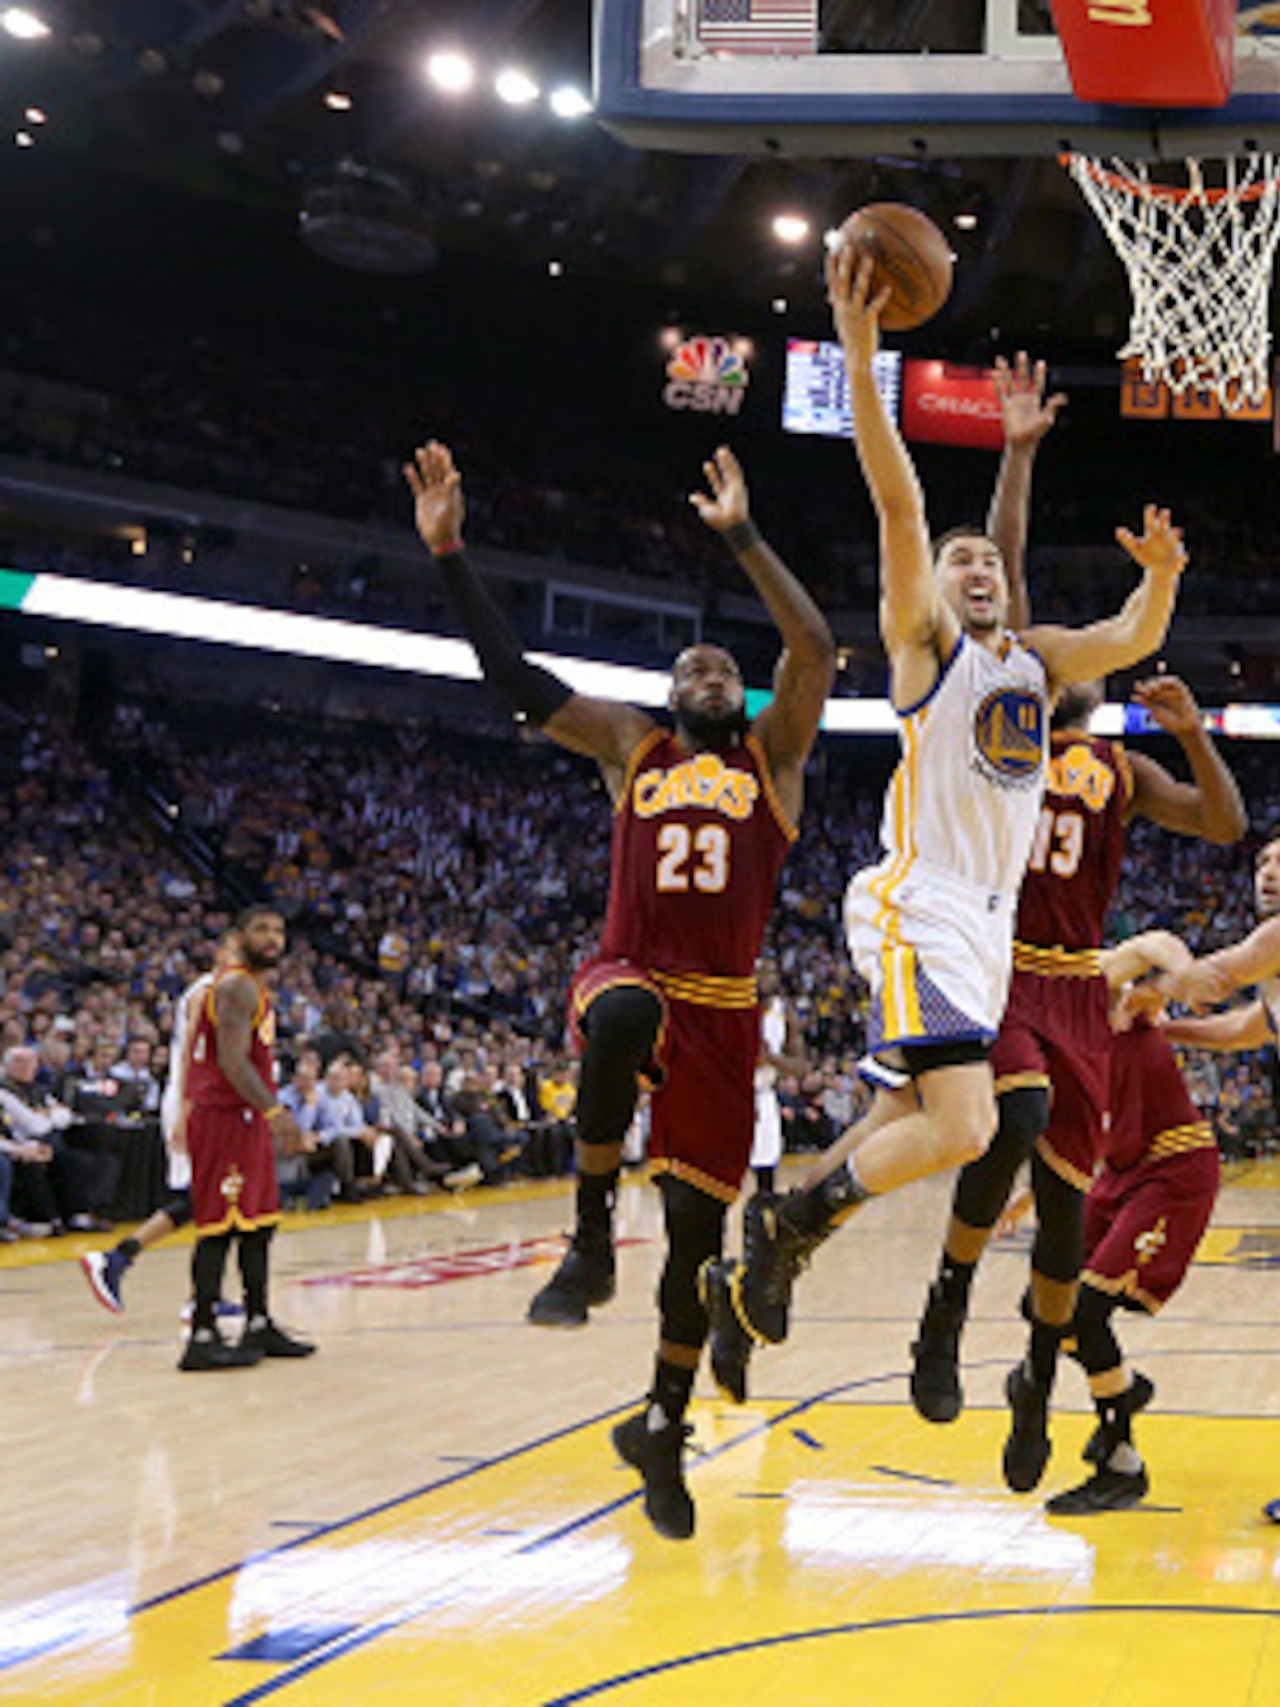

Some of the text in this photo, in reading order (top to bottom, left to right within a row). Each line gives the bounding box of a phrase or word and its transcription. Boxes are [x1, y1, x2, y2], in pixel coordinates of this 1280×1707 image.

[663, 382, 744, 415] CSN
[916, 392, 1003, 419] ORACL
[1018, 703, 1037, 731] 11
[633, 753, 759, 821] CAVS
[1046, 745, 1115, 812] AVS
[655, 823, 731, 893] 23
[1028, 805, 1086, 878] 13
